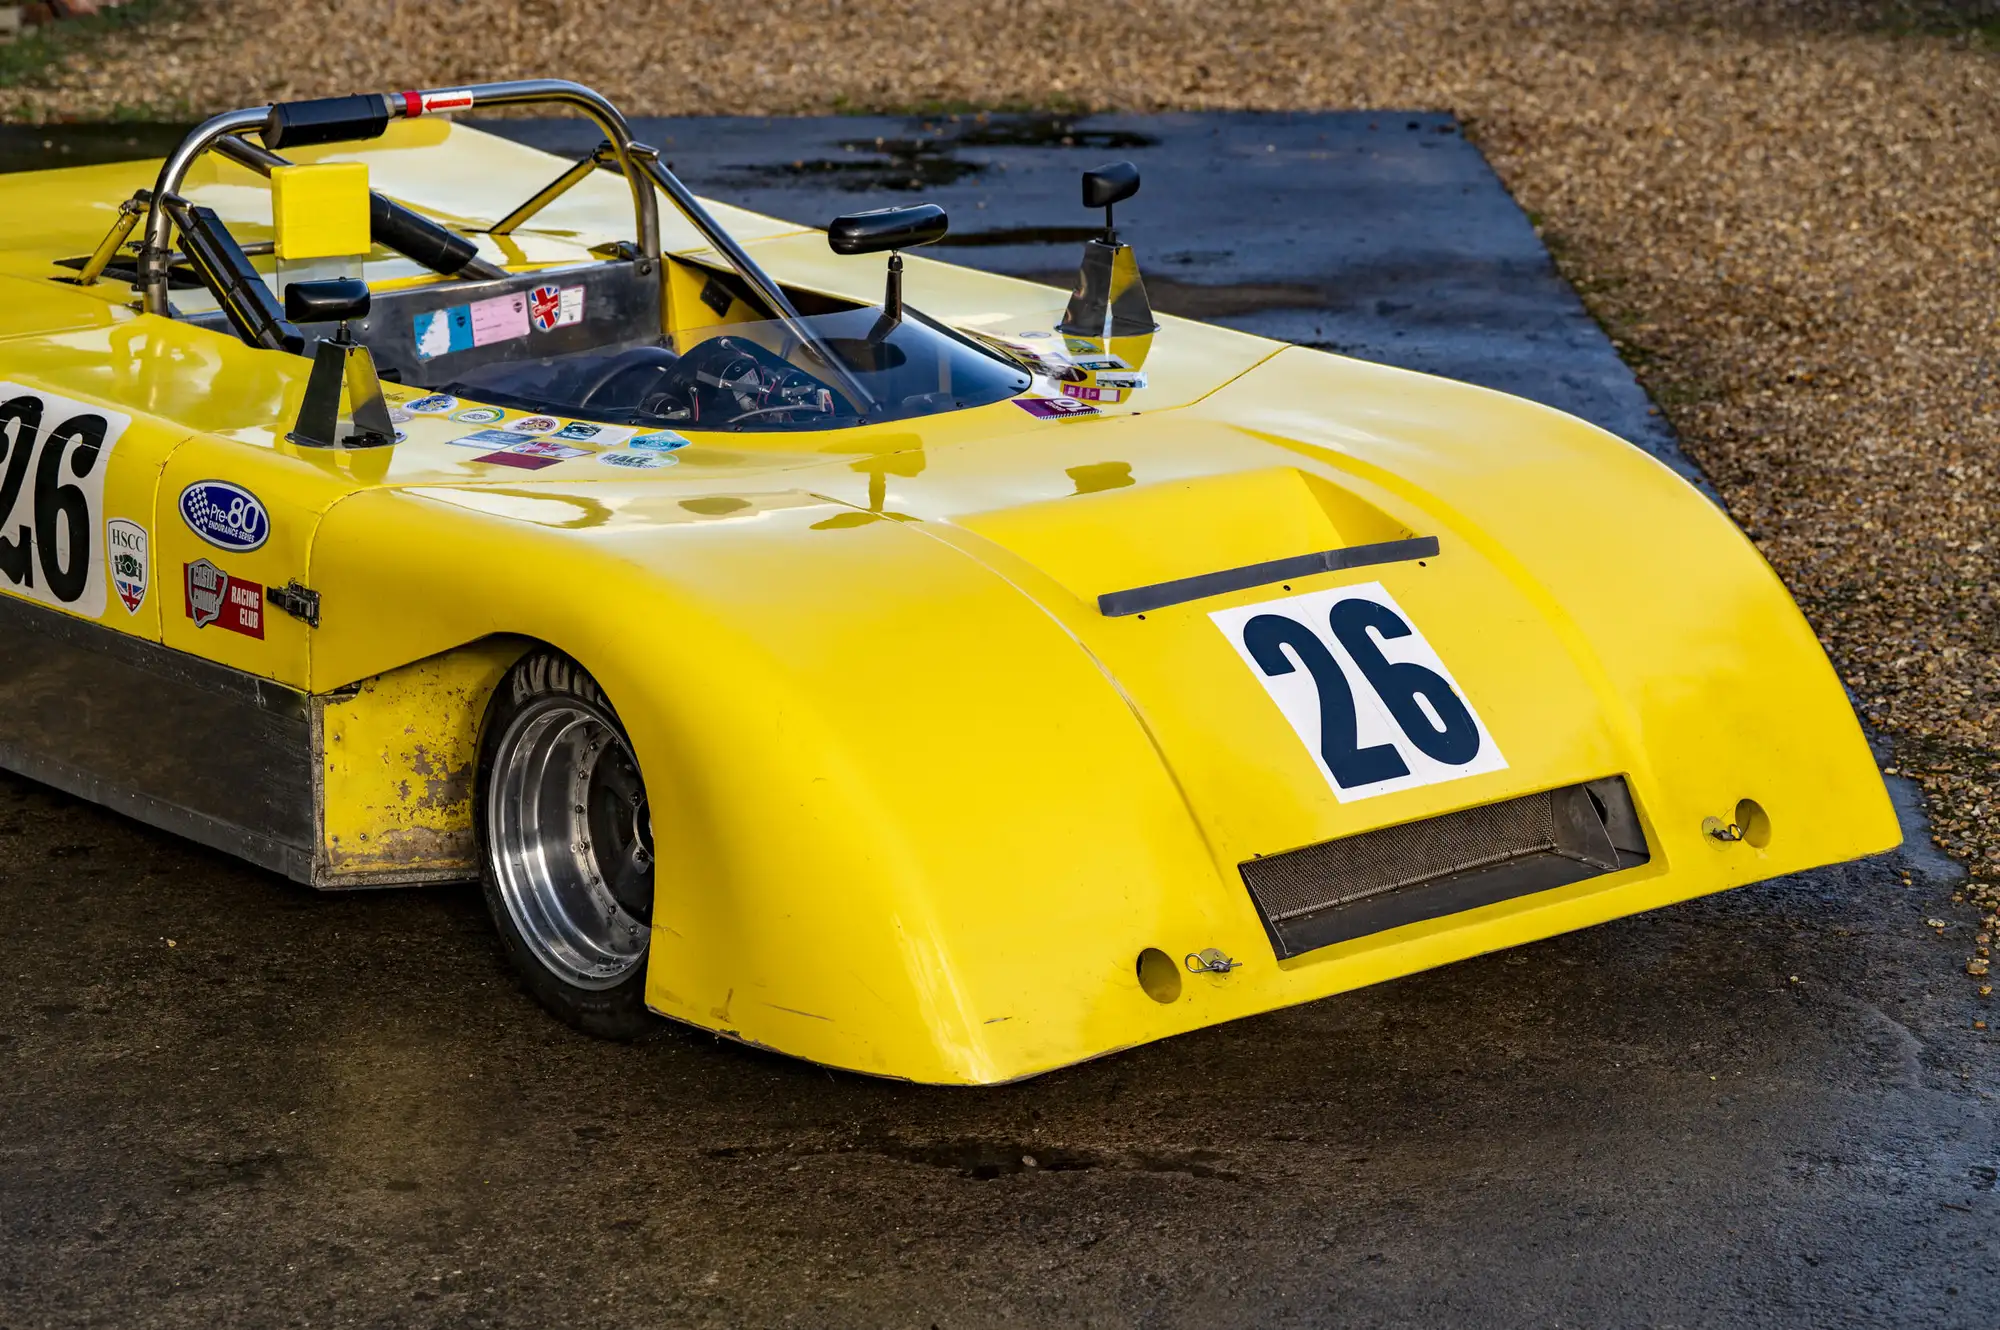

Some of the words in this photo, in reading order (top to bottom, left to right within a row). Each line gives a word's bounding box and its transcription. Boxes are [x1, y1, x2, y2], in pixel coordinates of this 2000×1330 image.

[0, 396, 108, 602] 26
[111, 527, 144, 553] HSCC
[208, 520, 239, 538] ENDURANCE
[238, 530, 255, 543] SERIES
[192, 566, 217, 590] CASTLE
[231, 586, 259, 610] RACING
[239, 608, 259, 629] CLUB
[1243, 598, 1480, 789] 26
